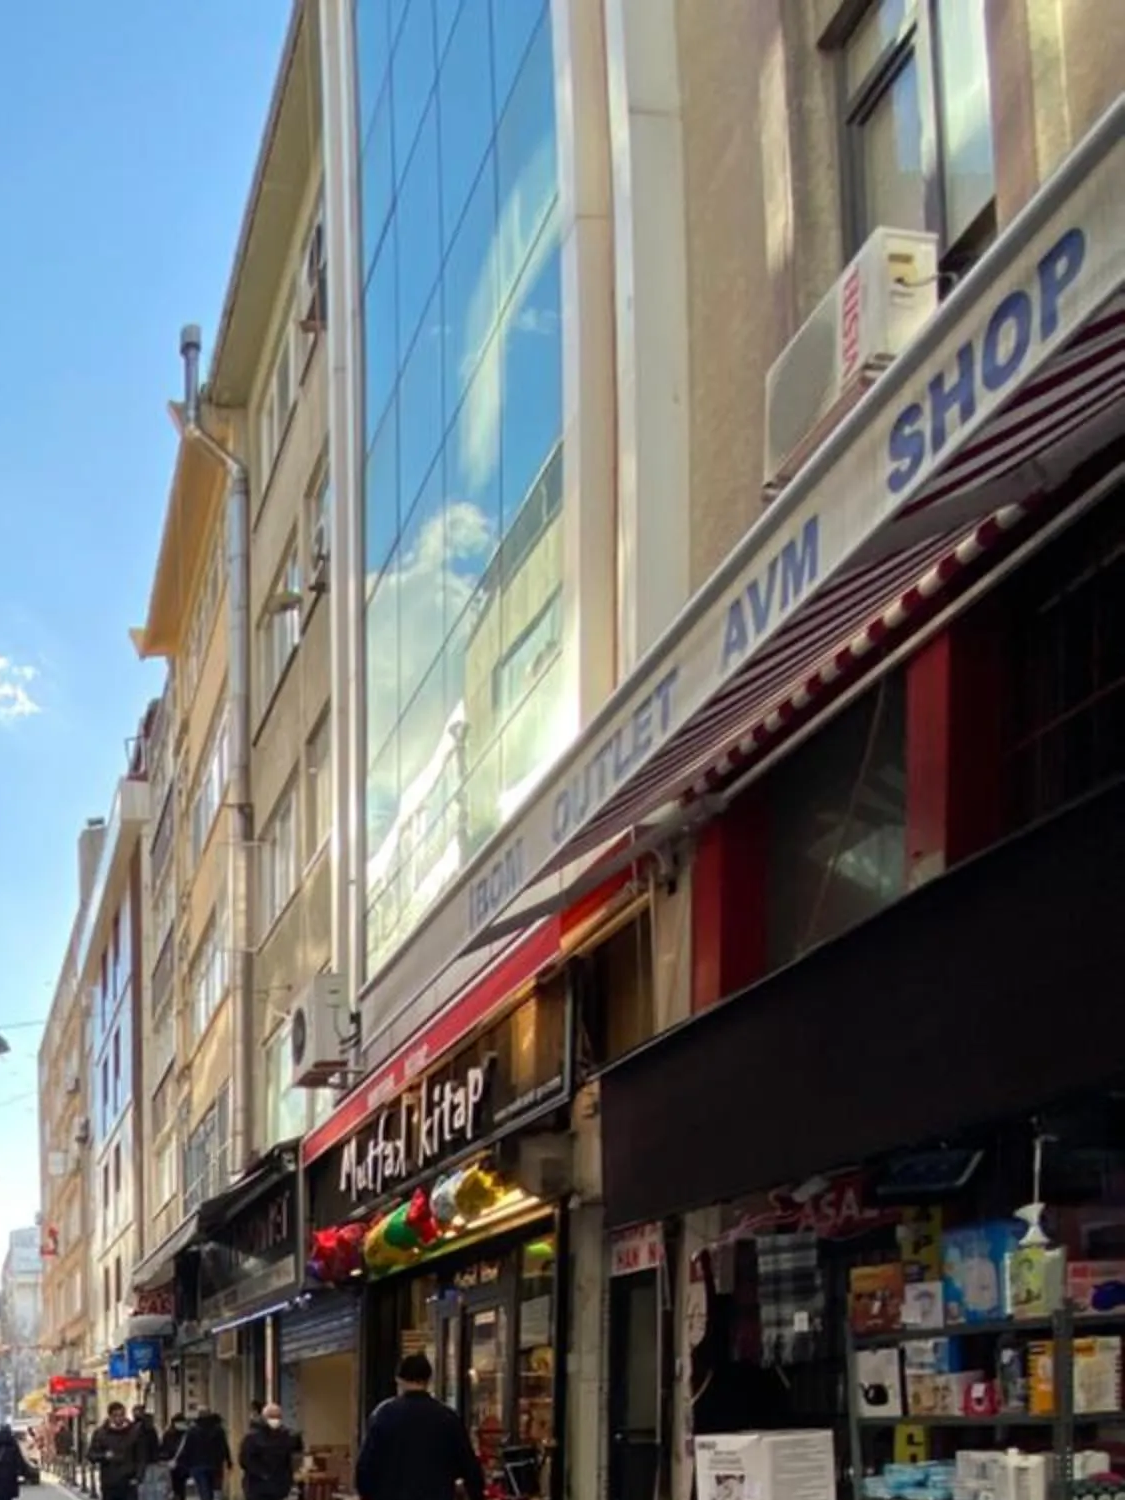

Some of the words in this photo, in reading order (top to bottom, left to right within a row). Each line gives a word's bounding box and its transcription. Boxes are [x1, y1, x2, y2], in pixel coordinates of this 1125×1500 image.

[551, 665, 679, 846] OUTLET
[720, 517, 820, 668] AVM
[886, 226, 1086, 494] SHOP
